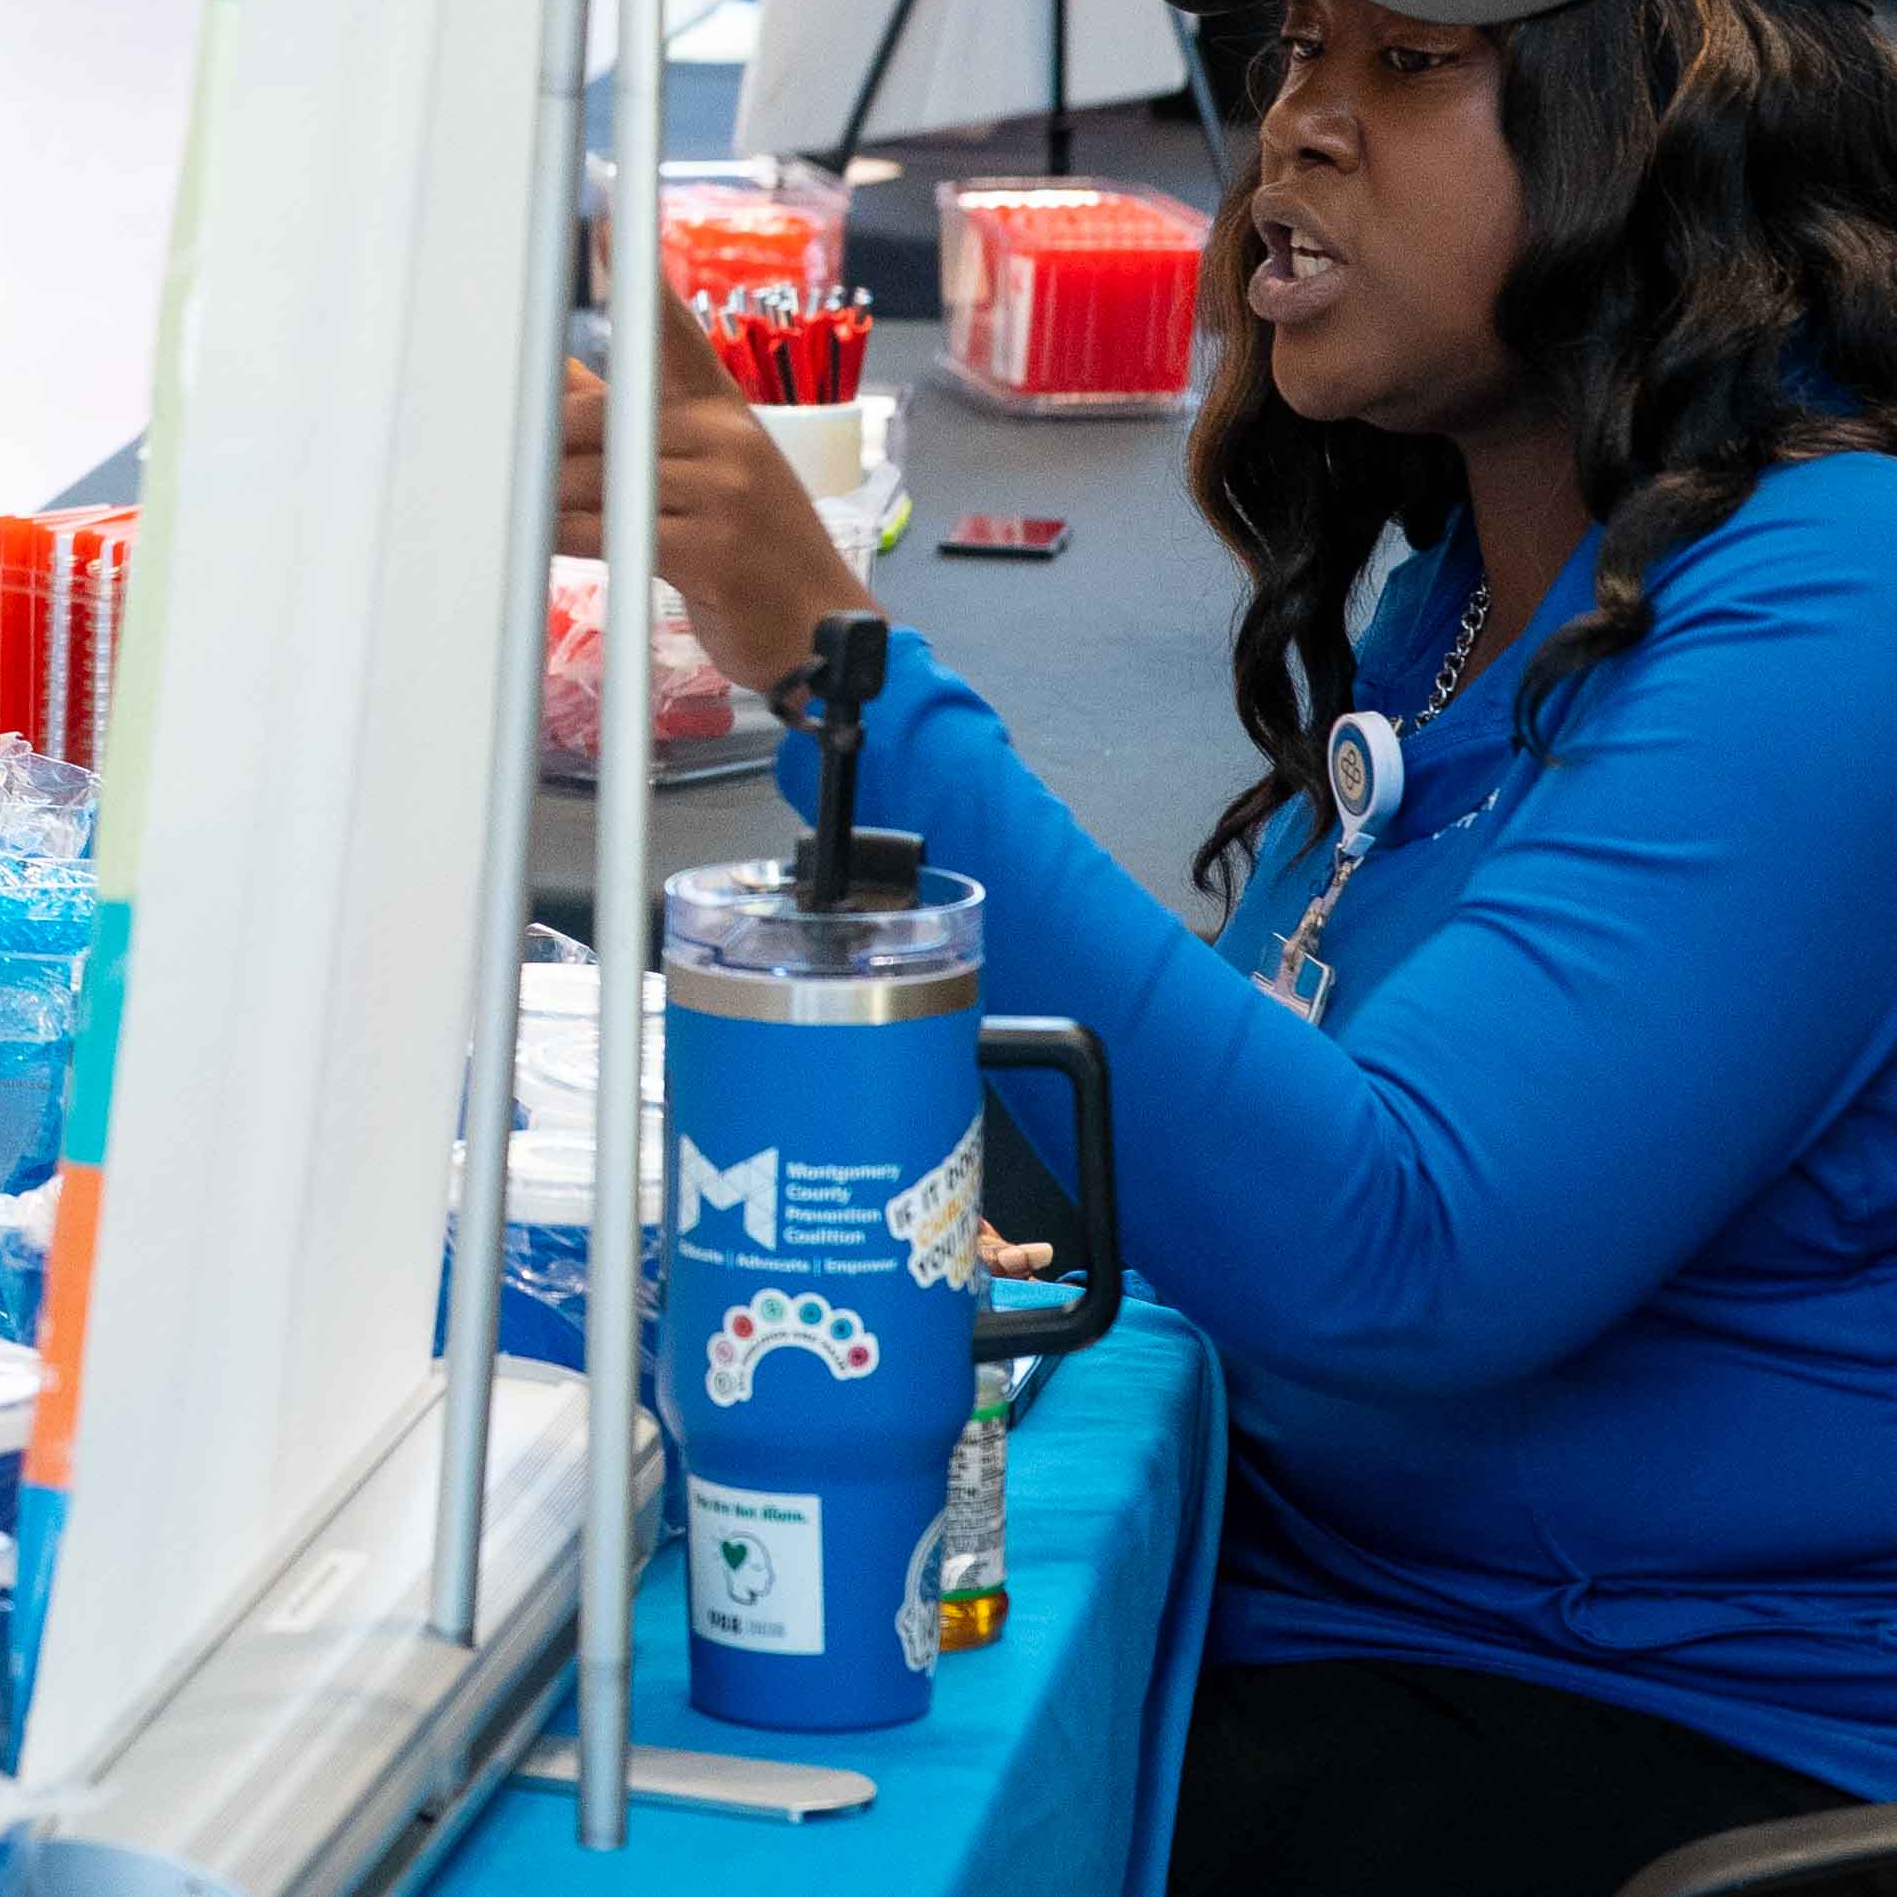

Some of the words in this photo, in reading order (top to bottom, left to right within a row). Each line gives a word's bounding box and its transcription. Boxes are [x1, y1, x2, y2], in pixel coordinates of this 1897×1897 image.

[786, 1162, 902, 1183] Montgomery
[785, 1182, 852, 1204] County
[785, 1206, 882, 1223] Prevention
[783, 1226, 866, 1245] Coalition
